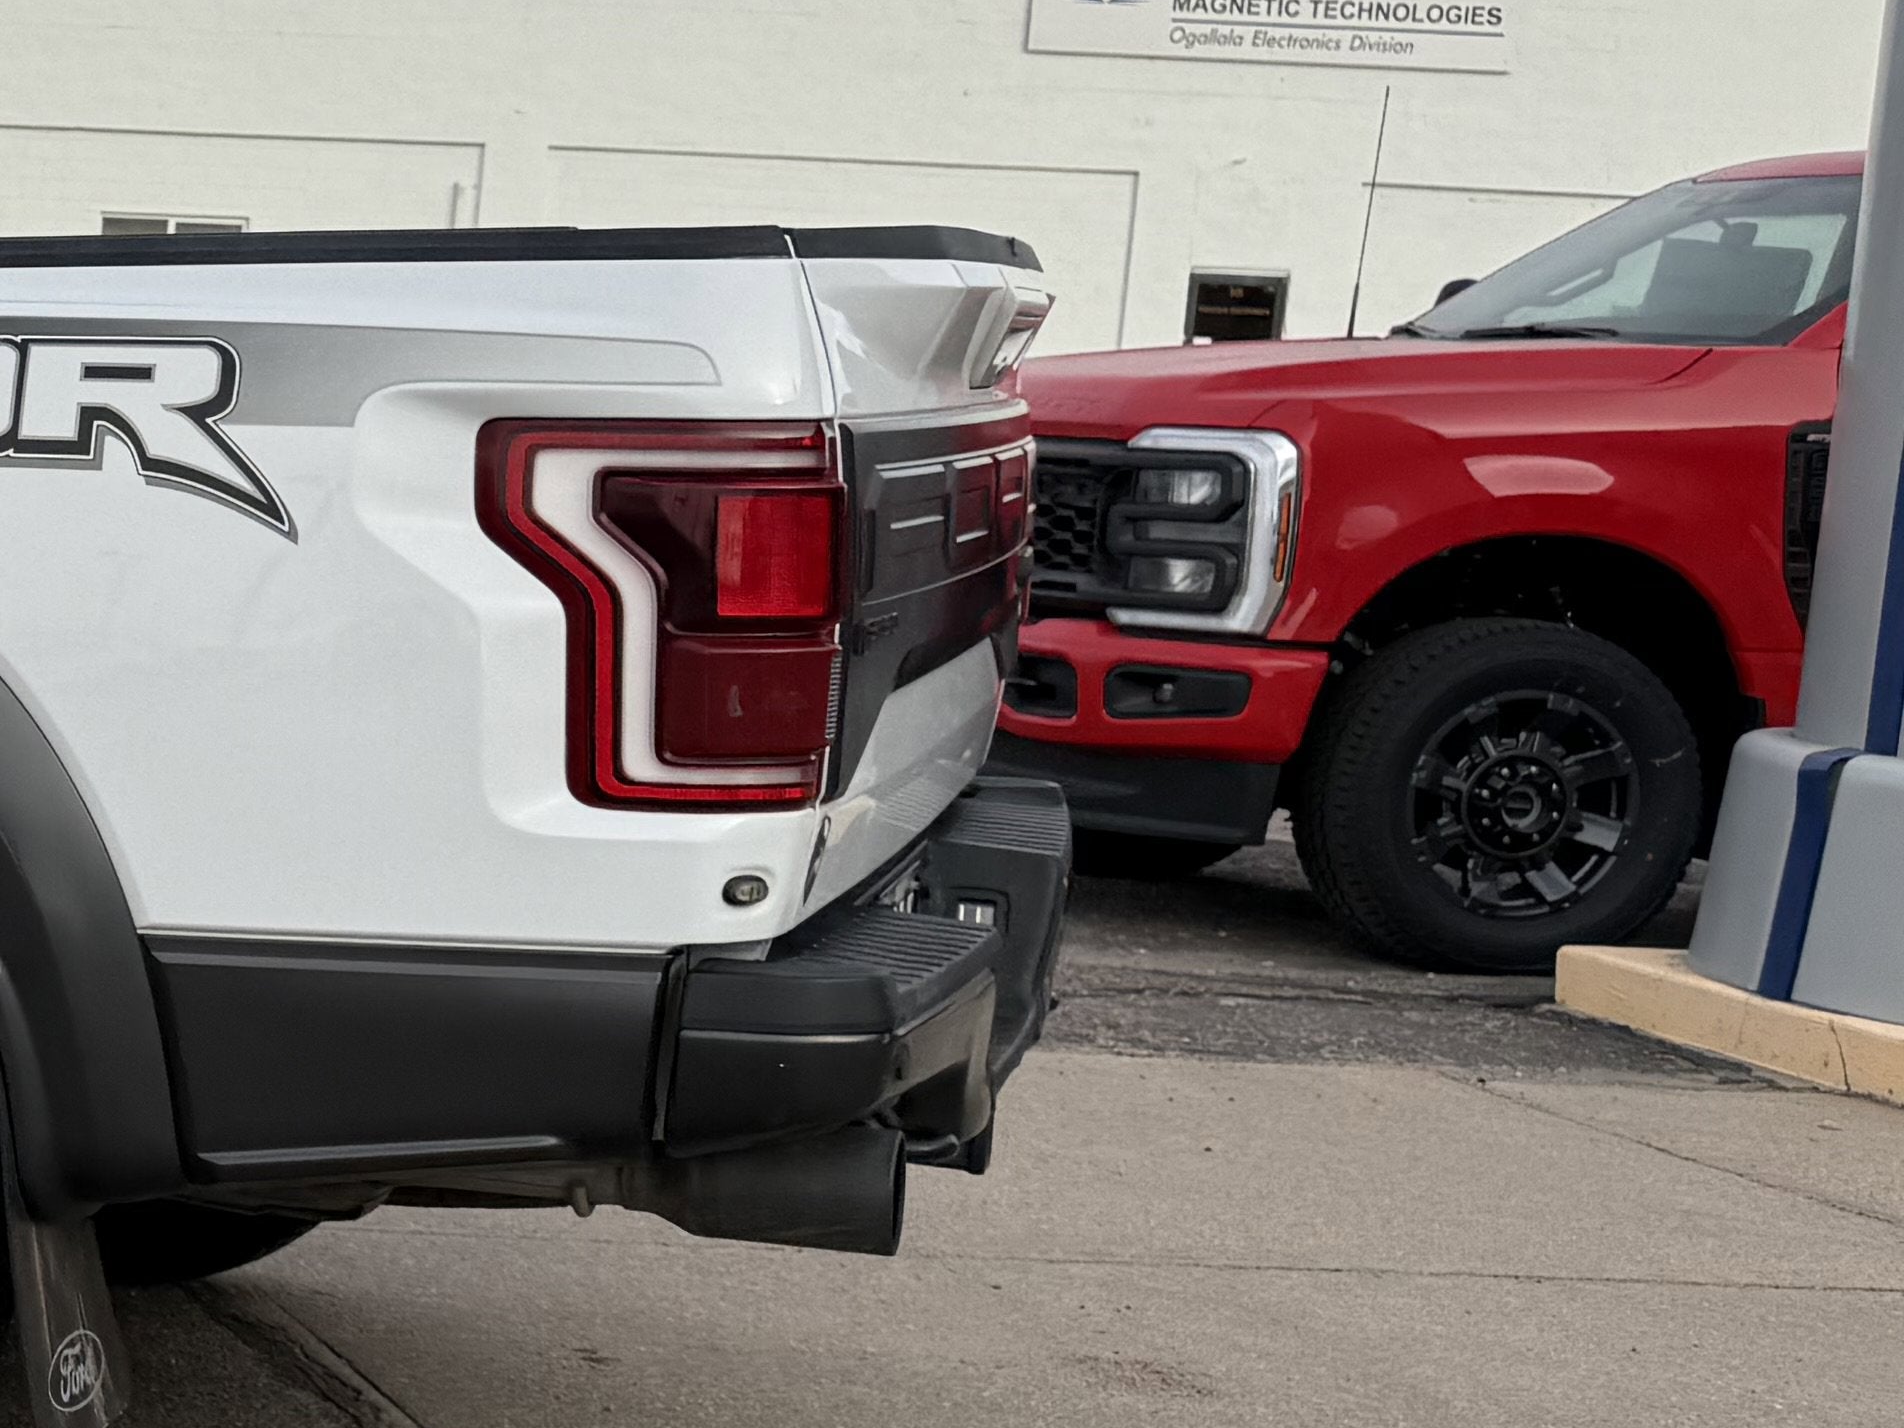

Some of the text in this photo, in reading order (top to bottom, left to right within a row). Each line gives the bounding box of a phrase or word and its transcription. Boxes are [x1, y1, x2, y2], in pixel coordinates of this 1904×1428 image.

[1168, 25, 1415, 56] Ogallala Electronics Division
